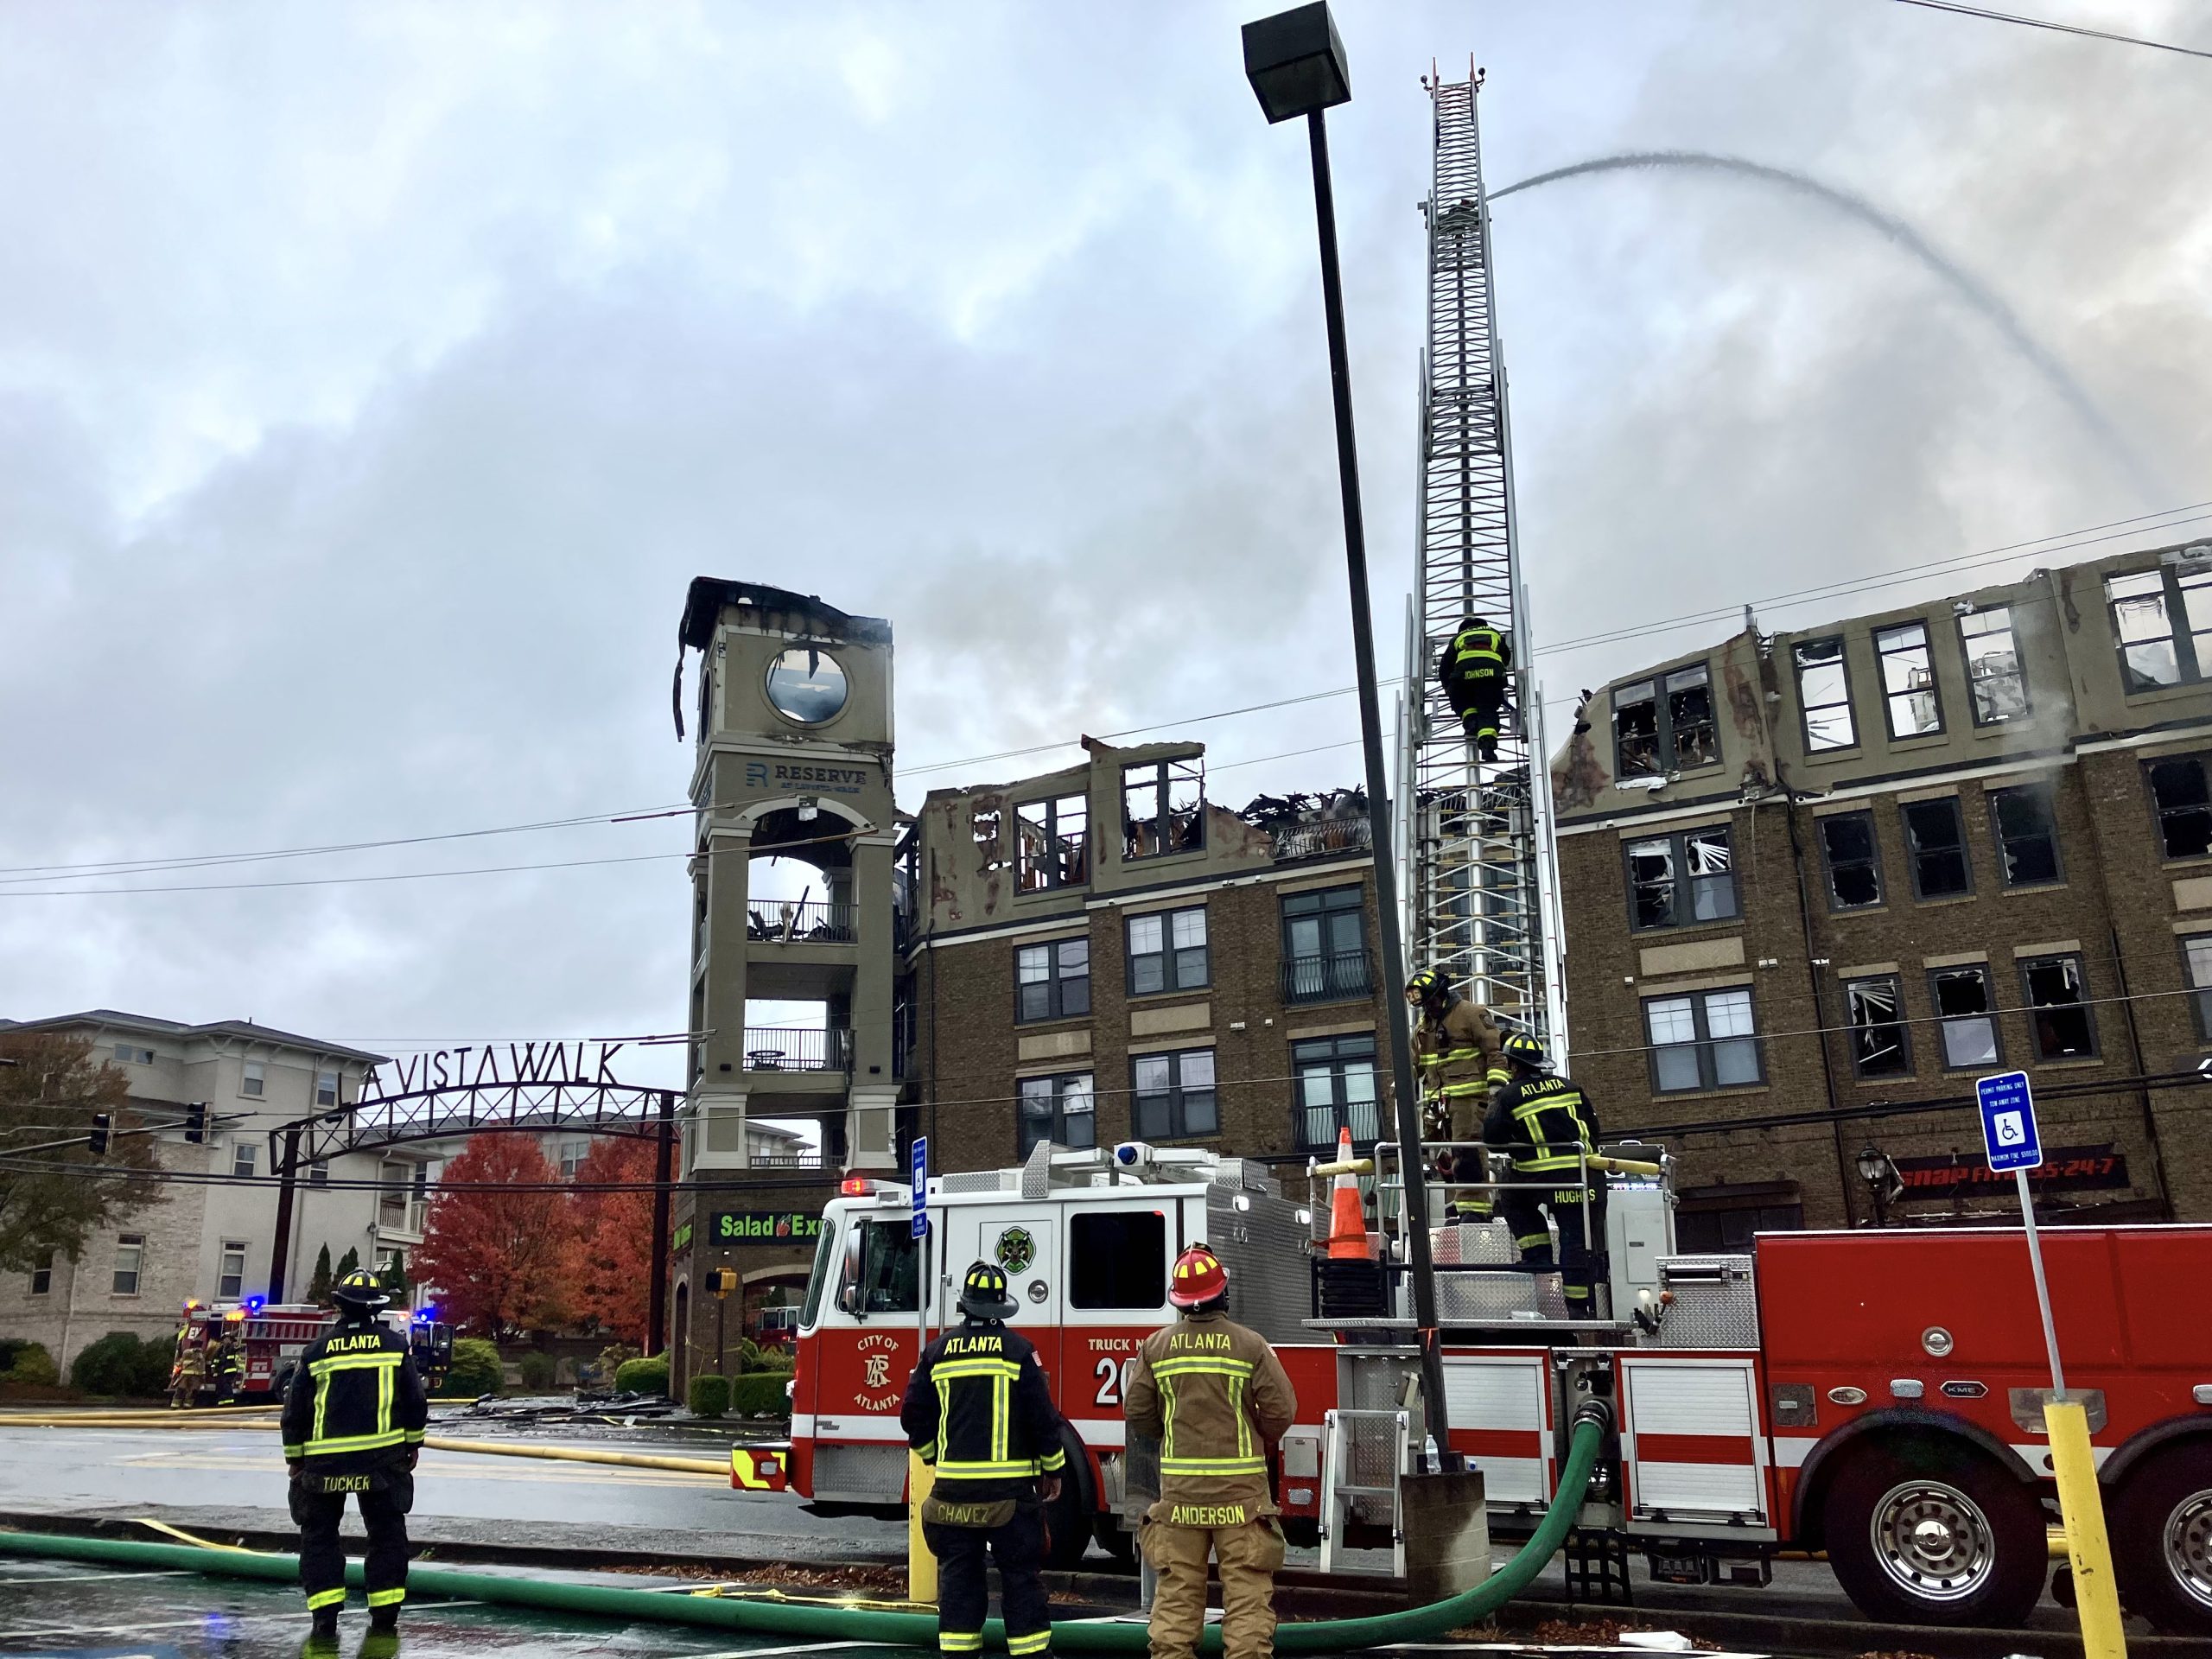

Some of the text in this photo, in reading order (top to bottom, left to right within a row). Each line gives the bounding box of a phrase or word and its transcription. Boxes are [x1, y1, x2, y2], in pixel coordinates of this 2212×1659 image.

[1465, 668, 1494, 680] JOHNSON
[775, 765, 867, 785] RESERVE
[338, 1041, 624, 1108] LA VISTA WALK
[1521, 1078, 1566, 1097] ATLANTA
[1554, 1189, 1596, 1203] HUGHS
[721, 1215, 773, 1236] Salad
[326, 1335, 381, 1354] ATLANTA
[857, 1335, 899, 1351] CITY OF
[944, 1336, 1002, 1355] ATLANTA
[1089, 1338, 1130, 1351] TRUCK
[1169, 1333, 1231, 1351] ATLANTA
[854, 1393, 900, 1411] ATLANTA
[323, 1476, 370, 1492] TUCKER
[938, 1504, 990, 1524] CHAVEZ
[1170, 1505, 1246, 1526] ANDERSON
